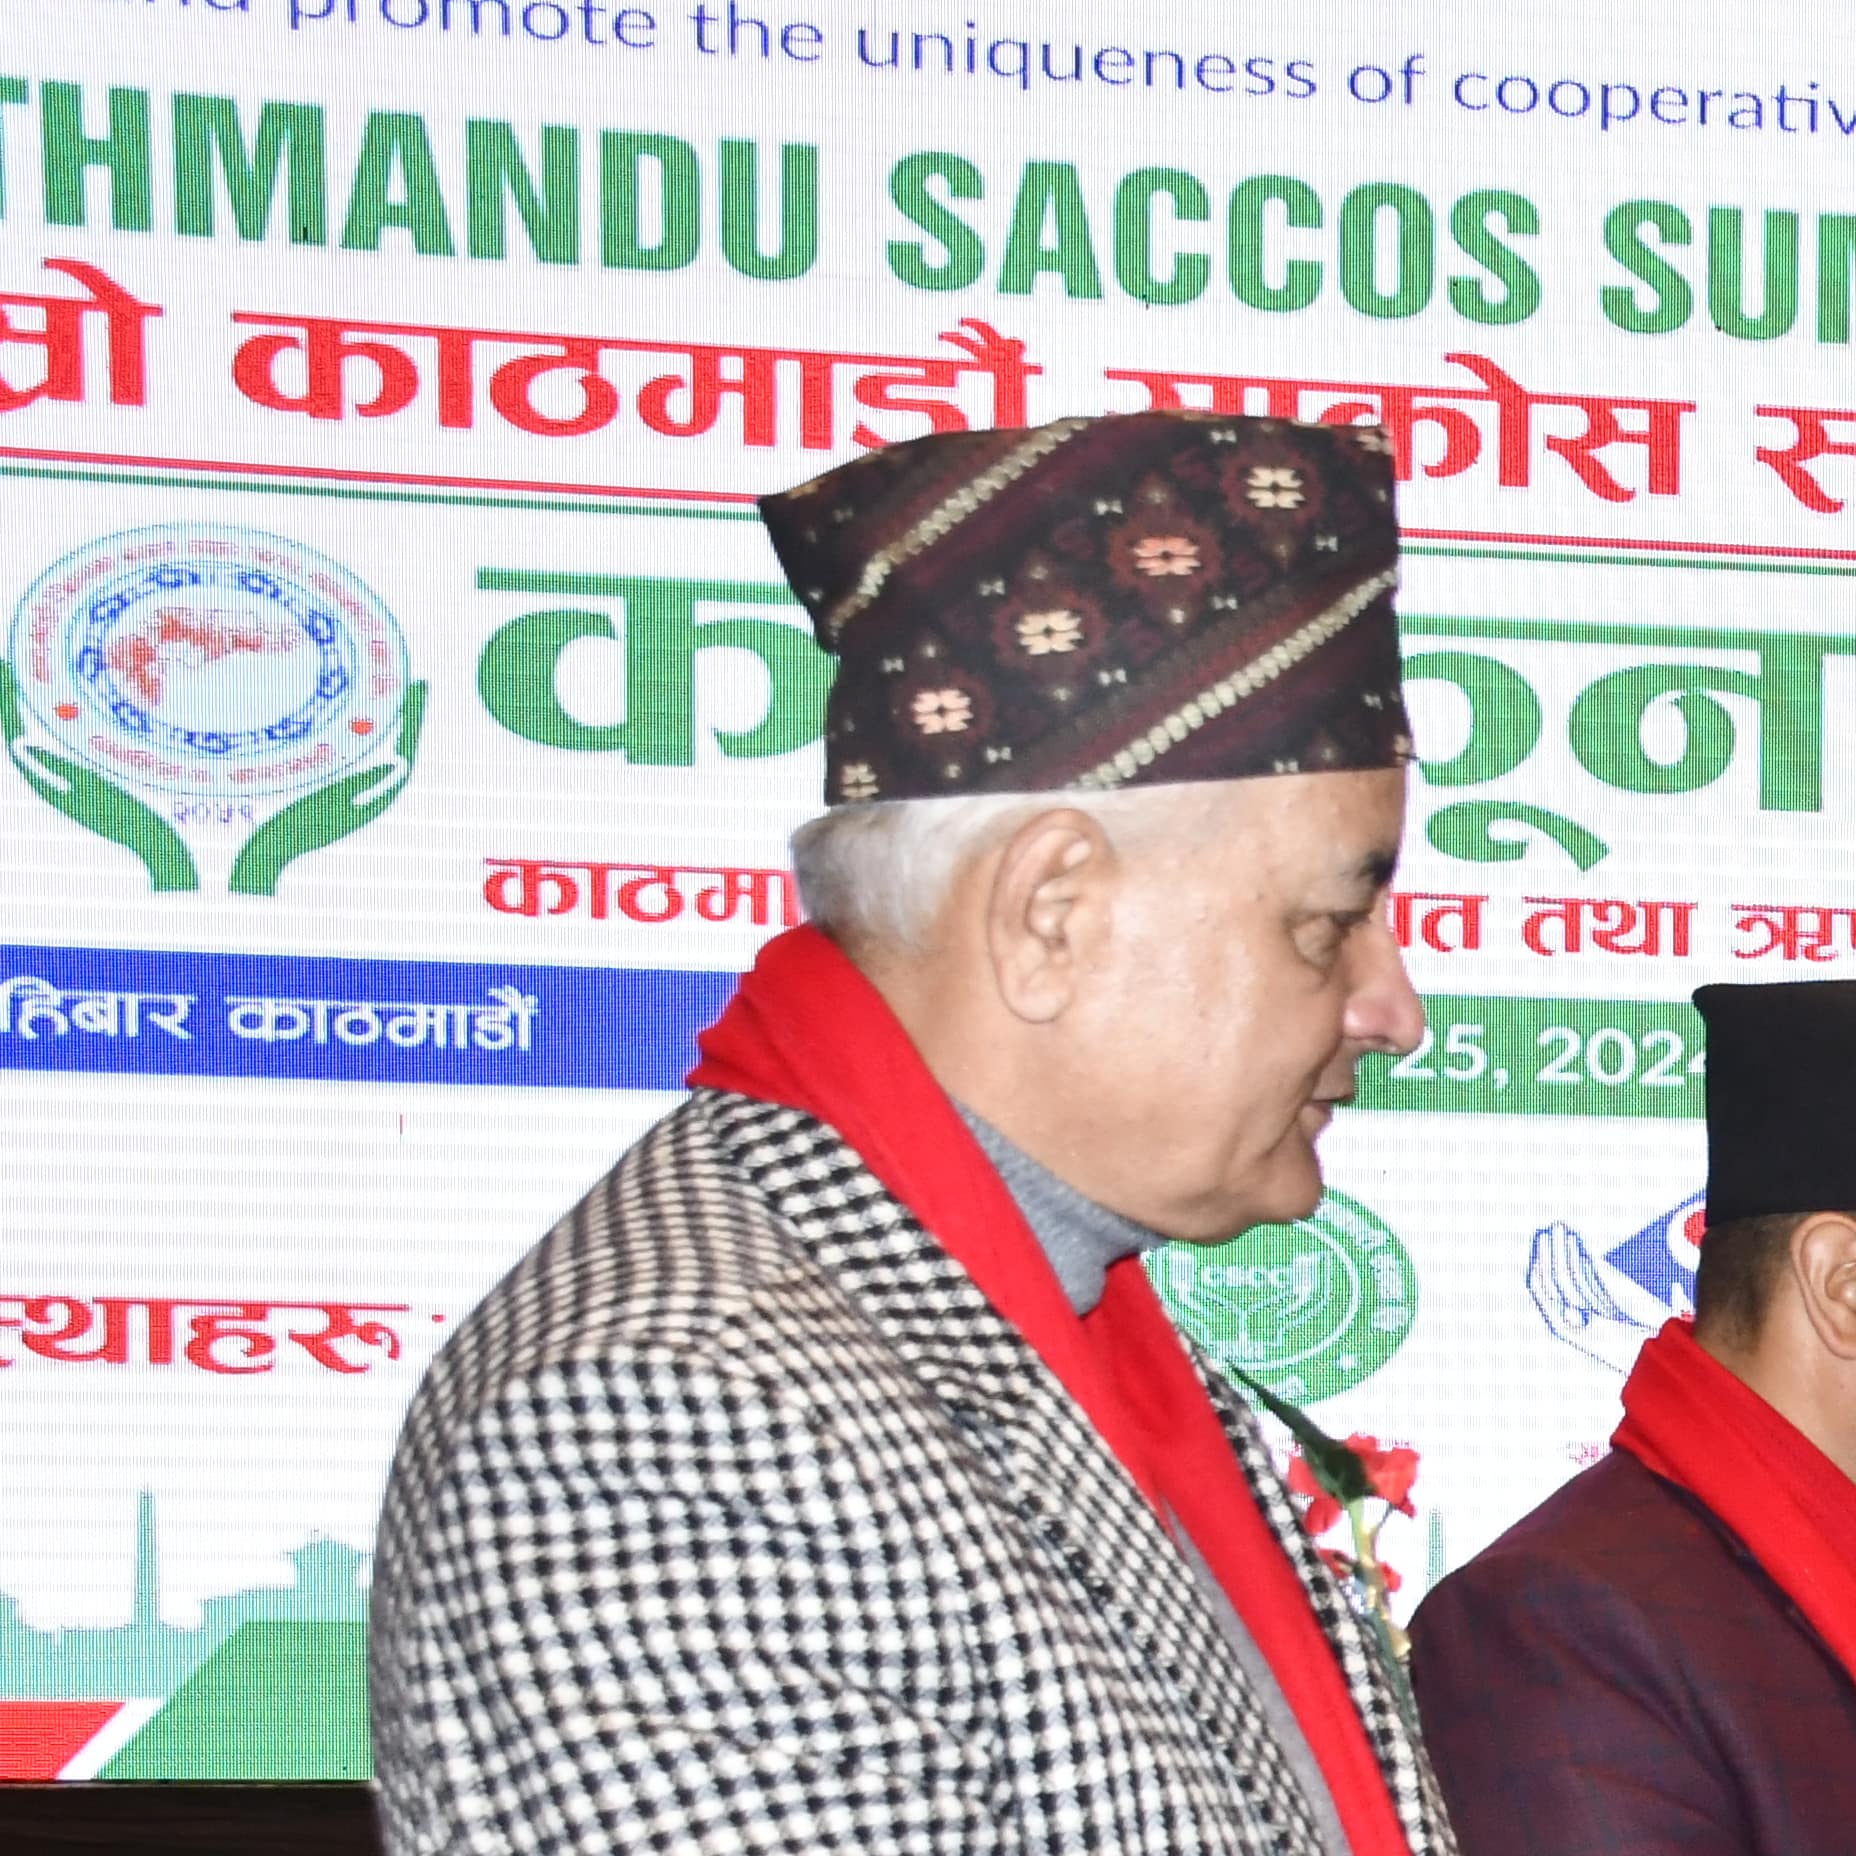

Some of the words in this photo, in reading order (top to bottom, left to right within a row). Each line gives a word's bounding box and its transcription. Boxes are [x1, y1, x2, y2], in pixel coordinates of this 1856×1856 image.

[690, 0, 824, 63] the
[857, 20, 1317, 101] uniqueness
[1347, 54, 1425, 106] of
[886, 151, 1542, 326] SACCOS
[484, 857, 800, 927] काठमा
[1522, 896, 1698, 957] तथा
[225, 984, 541, 1053] काठमाडौं
[1389, 1023, 1510, 1090] 25,
